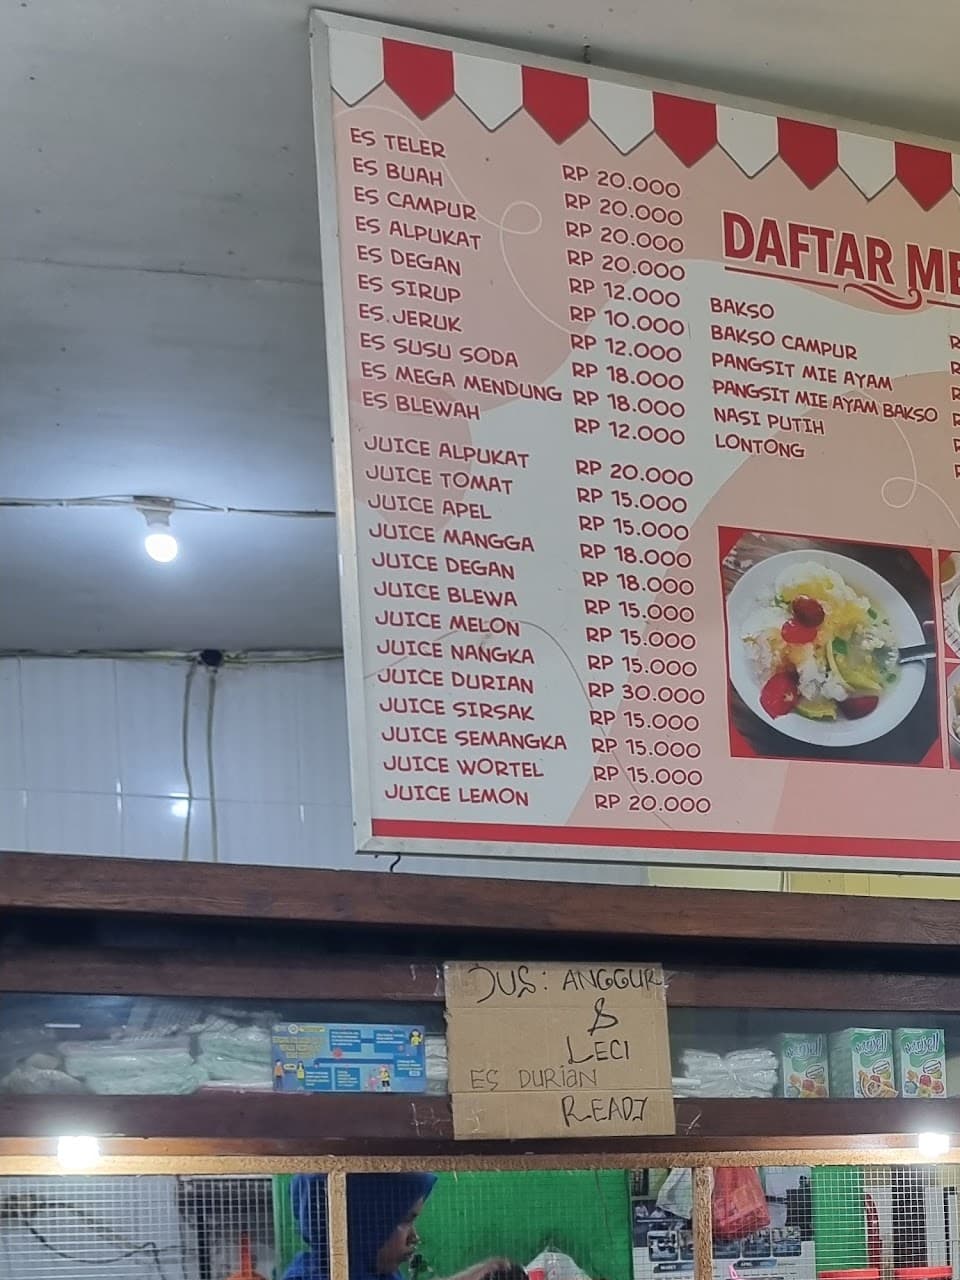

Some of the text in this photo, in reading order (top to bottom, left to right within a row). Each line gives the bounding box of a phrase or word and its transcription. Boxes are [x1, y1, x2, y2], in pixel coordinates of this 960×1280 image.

[350, 128, 446, 158] ES TELER
[353, 157, 442, 186] ES BUAH
[562, 165, 680, 198] RP 20.000
[354, 186, 476, 220] ES CAMPUR
[565, 193, 682, 225] RP 20.000
[356, 216, 481, 250] ES ALPUKAT
[566, 221, 683, 253] RP 20.000
[357, 245, 460, 276] ES DEGAN
[723, 212, 894, 285] DAFTAR
[567, 250, 685, 281] RP 20.000
[358, 274, 460, 303] ES SIRUP
[569, 278, 680, 308] RP 12.000
[359, 304, 462, 332] ES JERUK
[570, 306, 684, 336] RP 10.000
[710, 297, 774, 319] BAKSO
[360, 333, 518, 367] ES SUSU SODA
[571, 334, 682, 363] RP 12.000
[711, 325, 857, 360] BAKSO CAMPUR
[361, 362, 562, 401] ES MEGA MENDUNG
[572, 362, 684, 390] RP 18.000
[712, 352, 892, 391] PANGSIT MIE AYAM
[363, 391, 479, 419] ES BLEWAH
[573, 390, 685, 418] RP 18.000
[712, 379, 937, 422] PANGSIT MIE AYAM BAKSO
[574, 418, 685, 445] RP 12.000
[714, 408, 824, 434] NASI PUTIH
[364, 436, 528, 467] JUICE ALPUKAT
[716, 434, 804, 457] LONTONG
[366, 465, 512, 493] JUICE TOMAT
[576, 460, 693, 486] RP 20.000
[368, 494, 490, 519] JUICE APEL
[577, 487, 687, 513] RP 15.000
[370, 523, 534, 551] JUICE MANGGA
[579, 515, 689, 540] RP 15.000
[372, 553, 514, 580] JUICE DEGAN
[580, 543, 691, 568] RP 18.000
[376, 582, 517, 607] JUICE BLEWA
[582, 571, 694, 595] RP 18.000
[376, 611, 520, 637] JUICE MELON
[584, 599, 694, 624] RP 15.000
[586, 627, 696, 649] RP 15.000
[377, 640, 534, 664] JUICE NANGKA
[588, 655, 697, 677] RP 15.000
[378, 668, 533, 694] JUICE DURIAN
[588, 682, 705, 704] RP 30.000
[379, 698, 533, 721] JUICE SIRSAK
[589, 710, 699, 731] RP 15.000
[381, 727, 567, 750] JUICE SEMANGKA
[592, 738, 701, 758] RP 15.000
[384, 756, 544, 777] JUICE WORTEL
[593, 766, 702, 787] RP 15.000
[385, 785, 528, 806] JUICE LEMON
[595, 794, 711, 813] RP 20.000
[562, 968, 663, 992] ANGGUR
[566, 1035, 630, 1065] LECI
[470, 1069, 499, 1091] ES
